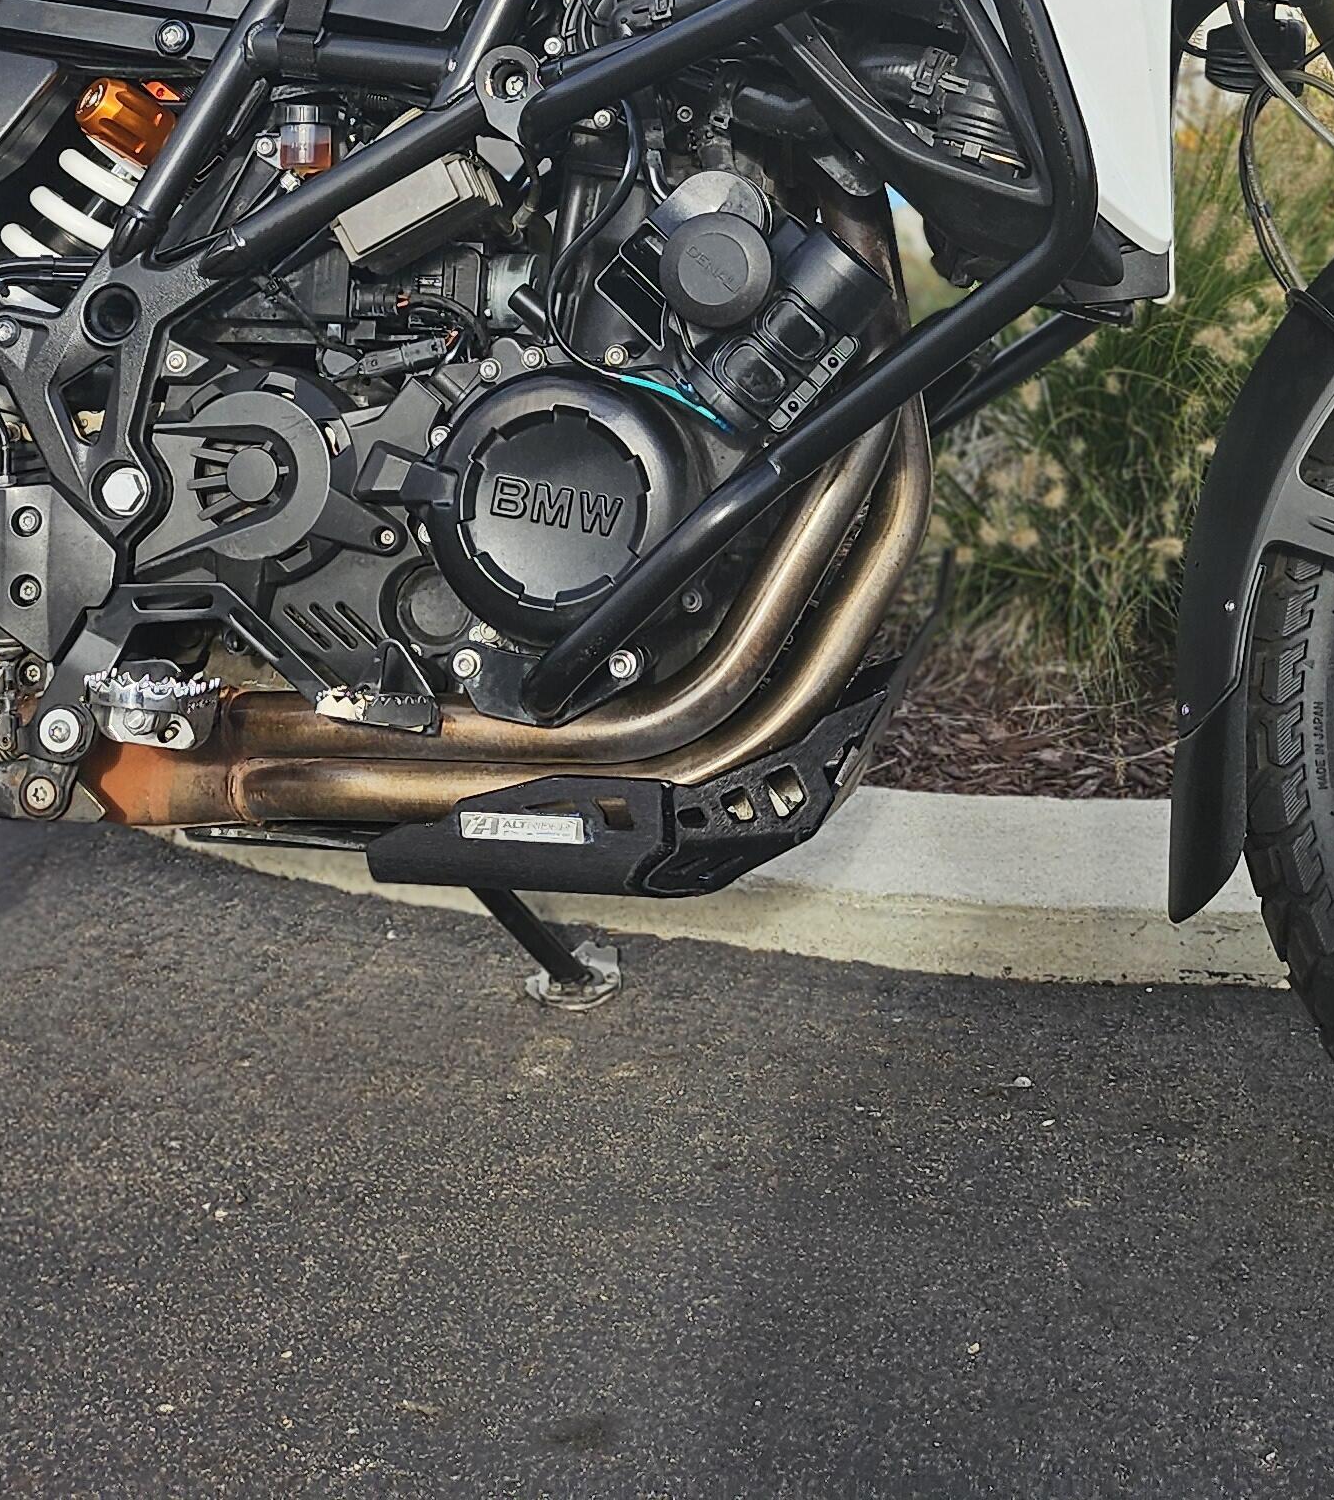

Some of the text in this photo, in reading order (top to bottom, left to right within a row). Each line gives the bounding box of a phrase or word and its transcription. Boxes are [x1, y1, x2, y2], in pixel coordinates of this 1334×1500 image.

[489, 474, 625, 538] BMW
[1312, 701, 1328, 790] MADE IN JAPAN
